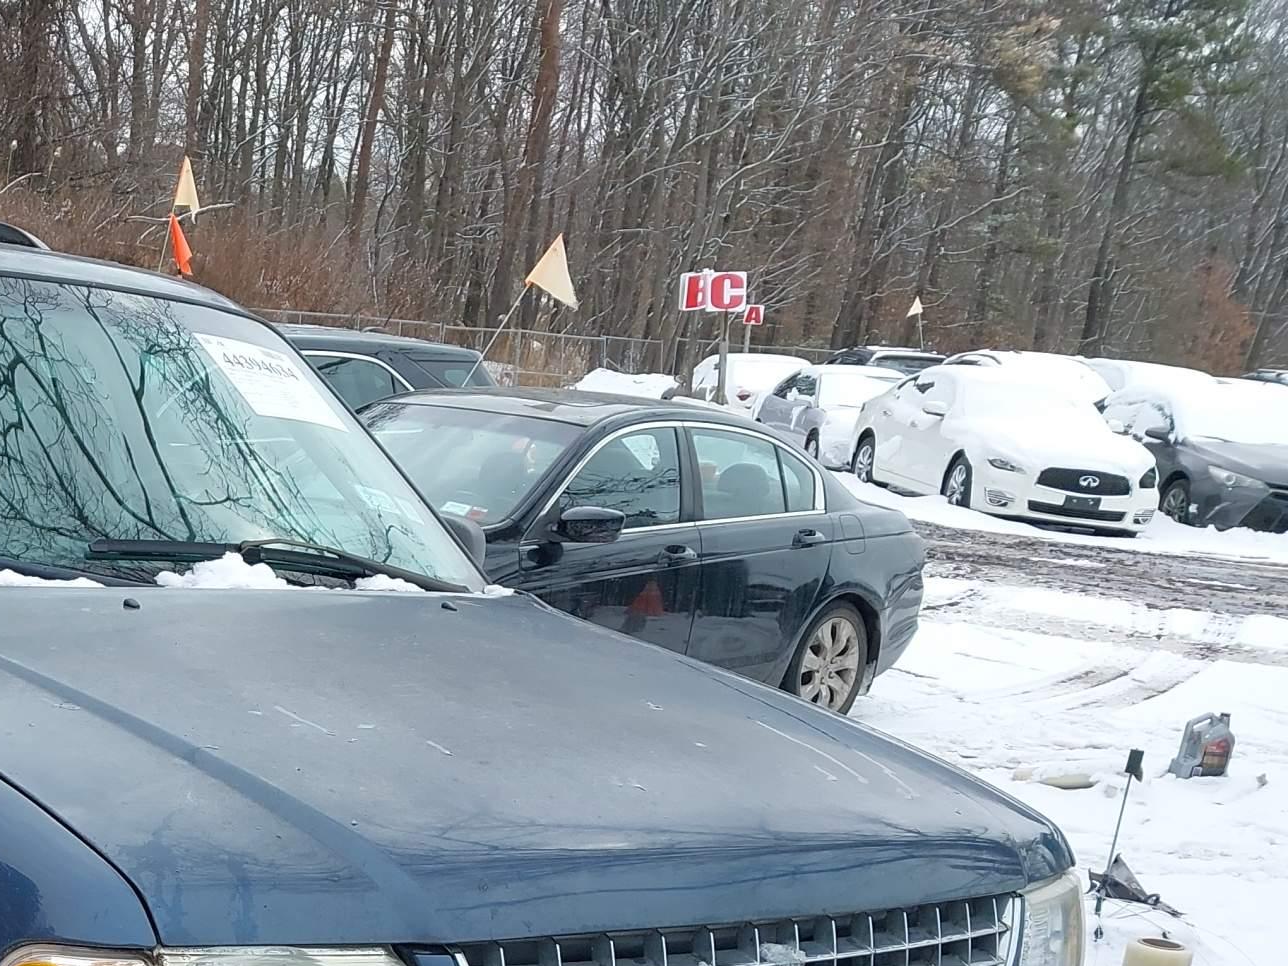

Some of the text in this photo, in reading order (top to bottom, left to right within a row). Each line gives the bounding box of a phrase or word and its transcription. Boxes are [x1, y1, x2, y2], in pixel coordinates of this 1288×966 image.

[710, 273, 745, 310] C
[744, 306, 762, 324] A
[222, 351, 300, 382] 44394634
